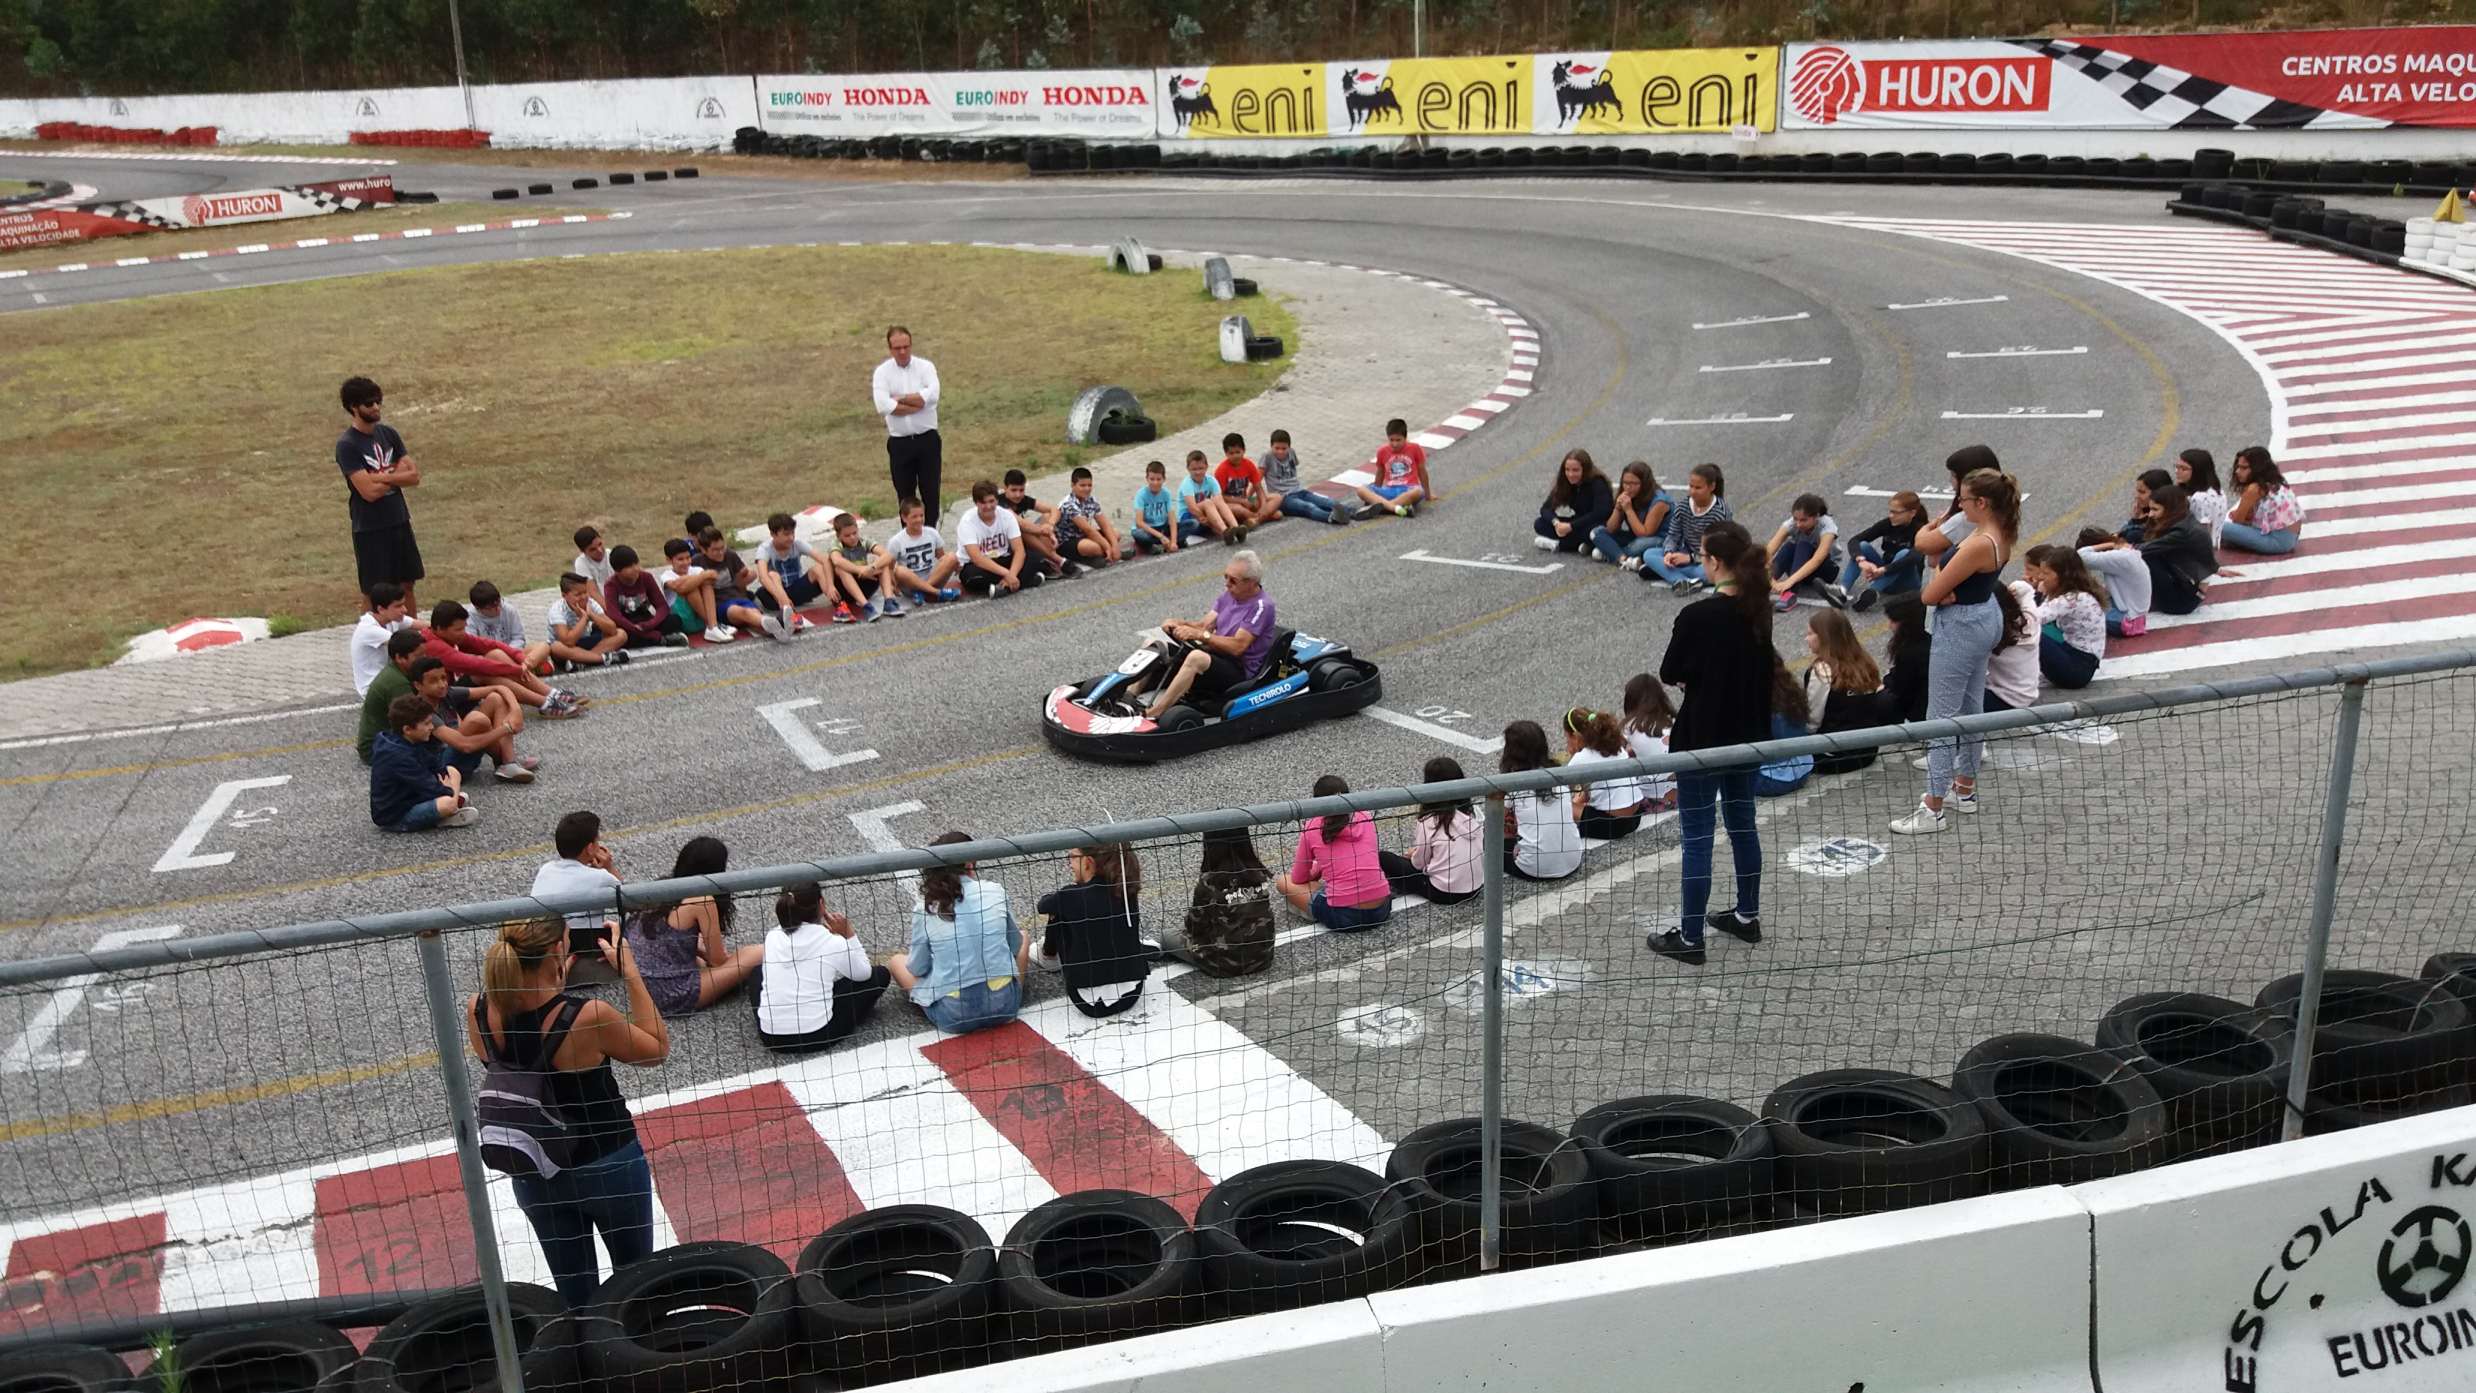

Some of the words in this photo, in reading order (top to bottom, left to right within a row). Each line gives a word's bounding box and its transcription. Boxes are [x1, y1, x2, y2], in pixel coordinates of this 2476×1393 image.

[2281, 54, 2397, 76] CENTROS
[1042, 86, 1149, 106] HONDA
[1417, 61, 1518, 131] eni
[1641, 53, 1758, 128] eni
[1879, 64, 2035, 107] HURON
[2335, 82, 2402, 103] ALTA
[2410, 81, 2476, 102] VELO
[771, 91, 833, 106] EUROINDY
[843, 88, 931, 106] HONDA
[956, 90, 1029, 106] EUROINDY
[1231, 69, 1316, 133] eni
[217, 196, 277, 217] HURON
[20, 228, 80, 244] VELOCIDADE
[906, 548, 933, 570] 25
[1248, 683, 1292, 707] TECNIROLO
[2224, 1177, 2393, 1393] ESCOLA
